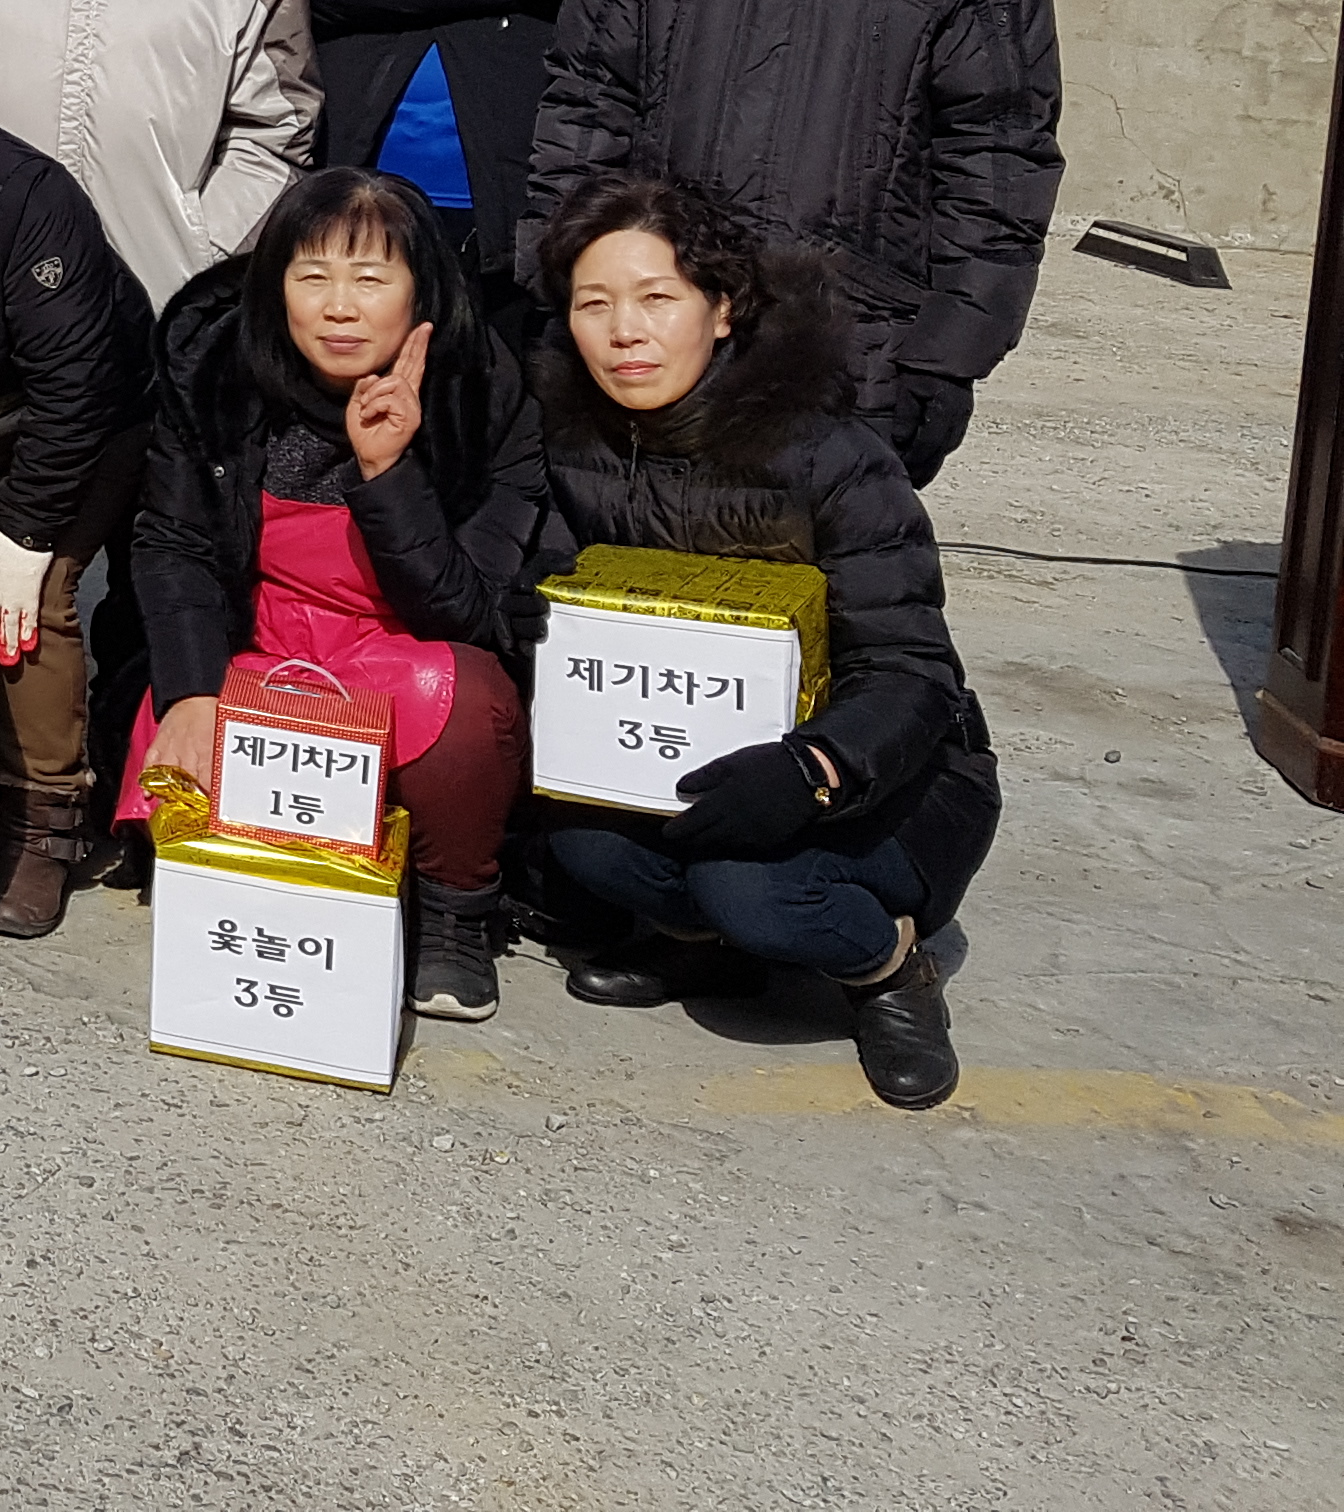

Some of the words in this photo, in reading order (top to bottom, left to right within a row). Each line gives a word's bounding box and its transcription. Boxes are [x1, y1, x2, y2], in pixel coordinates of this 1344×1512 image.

[566, 657, 744, 711] 제기차기
[231, 733, 371, 786] 제기차기
[618, 719, 691, 760] 3등
[270, 790, 324, 825] 1등
[207, 919, 334, 971] 윷놀이
[234, 977, 304, 1018] 3등
